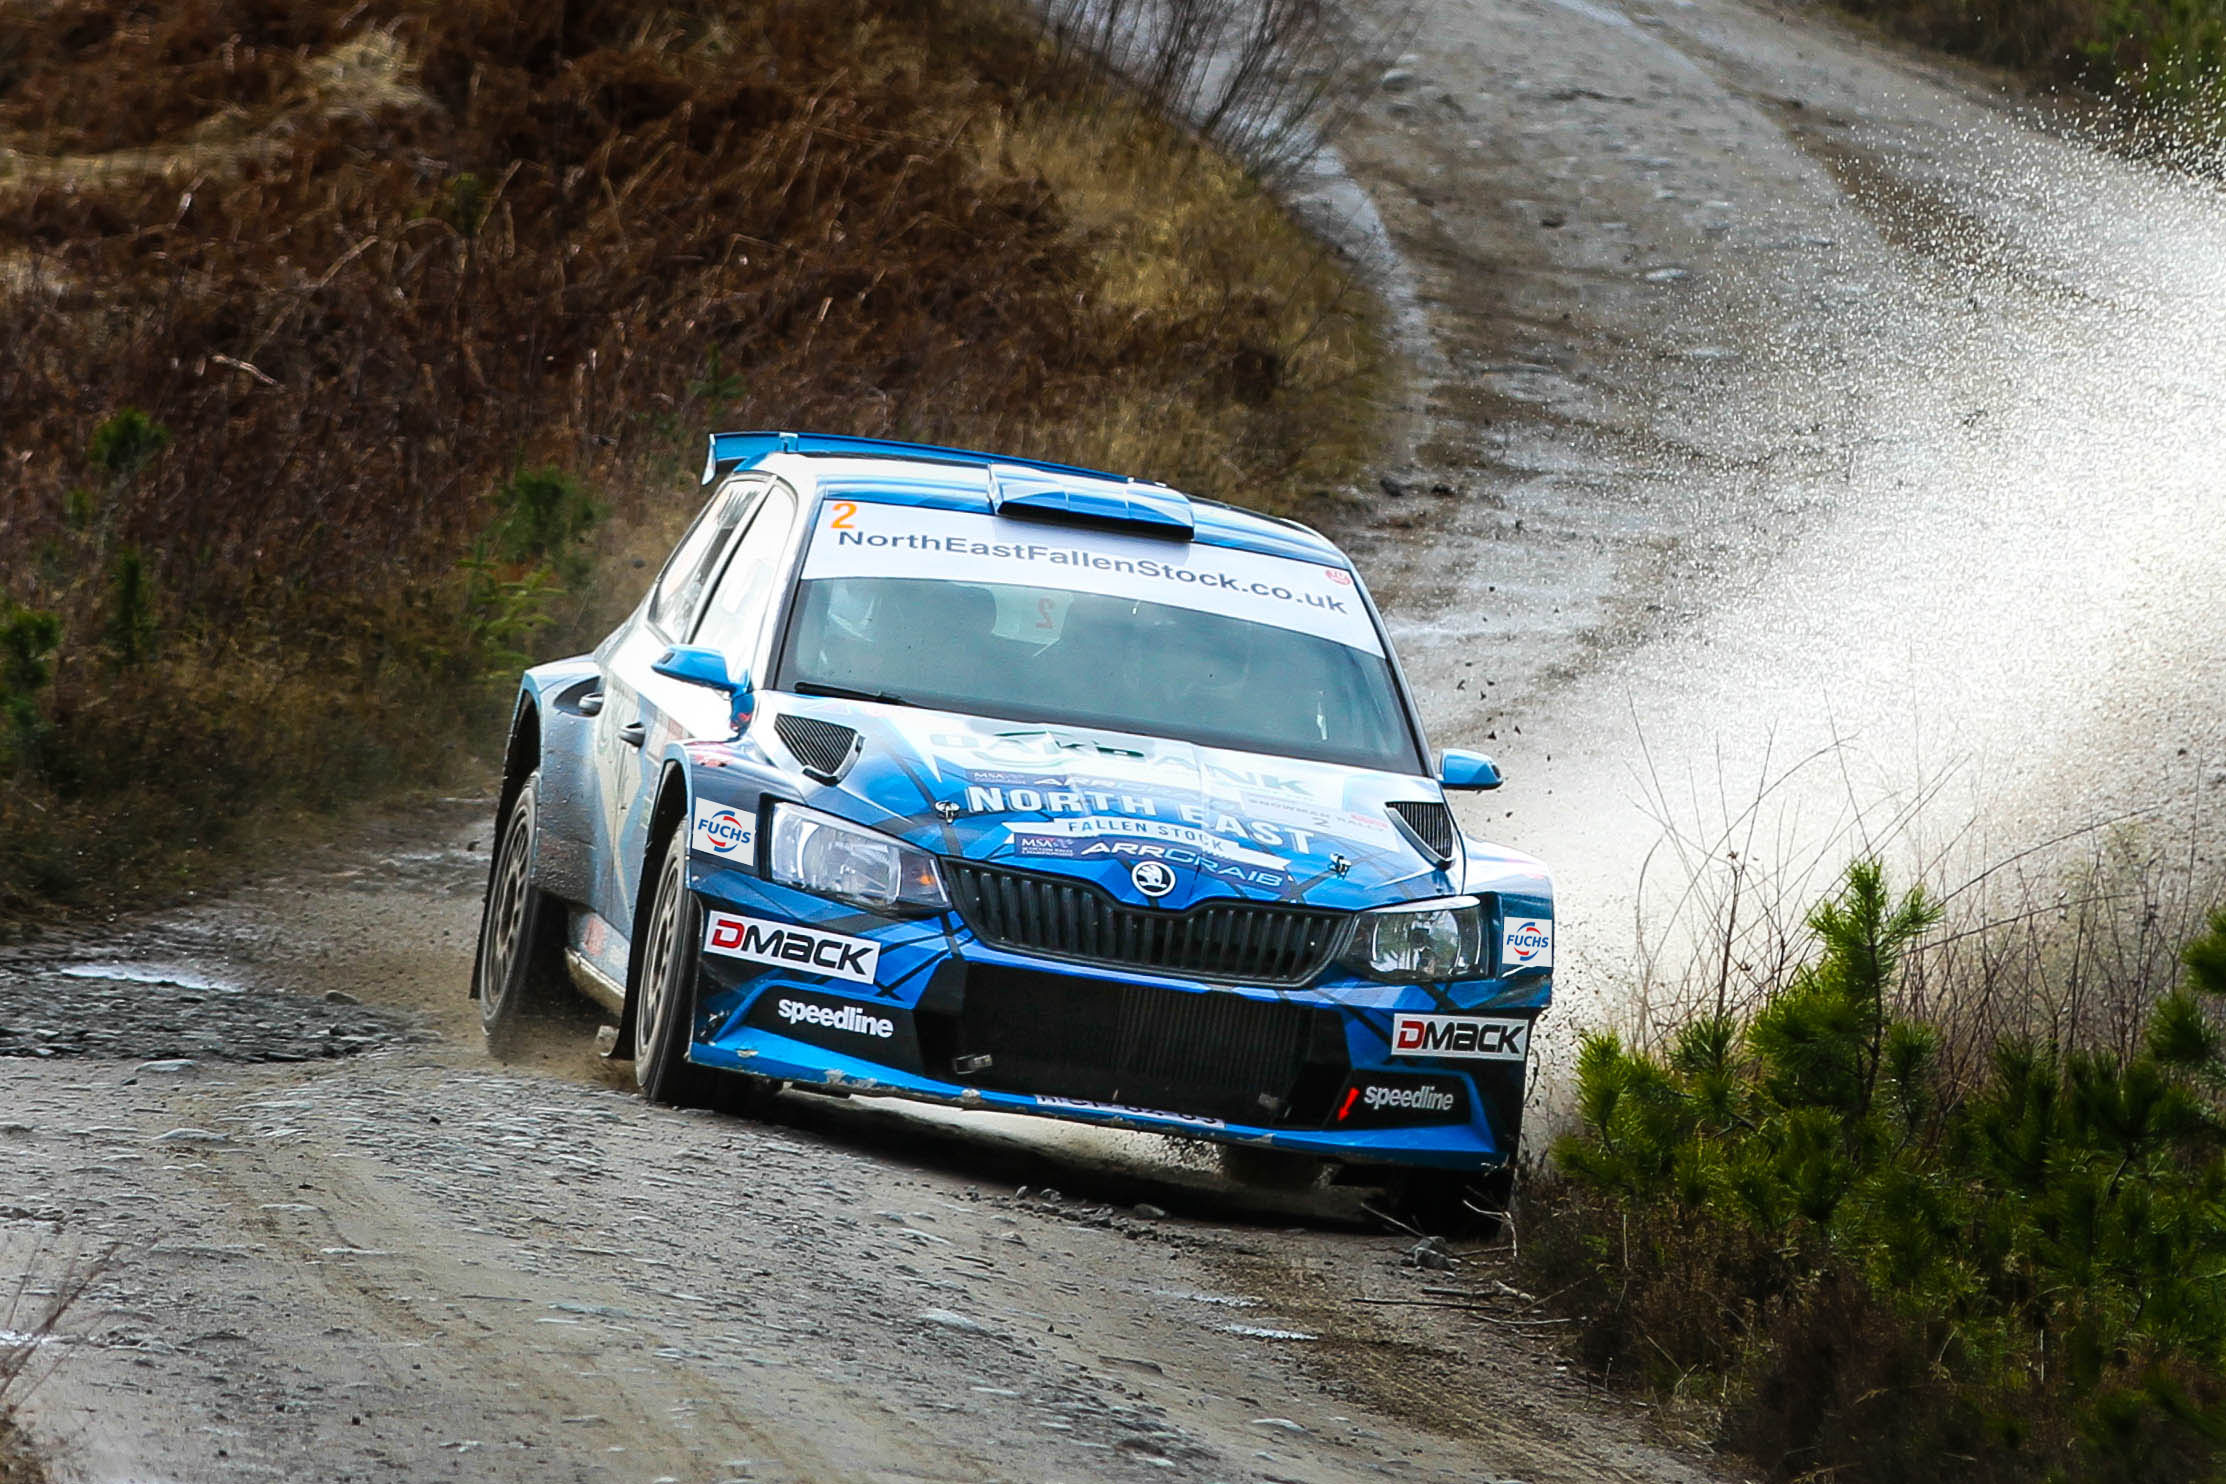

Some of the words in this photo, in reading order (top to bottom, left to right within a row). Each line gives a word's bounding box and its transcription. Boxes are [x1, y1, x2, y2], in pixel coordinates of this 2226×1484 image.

[831, 502, 857, 529] 2
[838, 530, 1348, 615] NorthEastFallenStock.co.uk
[698, 818, 751, 845] FUCHS
[967, 786, 1158, 816] NORTH
[1180, 803, 1315, 855] EAST
[1021, 837, 1054, 849] MSA
[1068, 819, 1148, 833] FALLEN
[1157, 825, 1224, 851] STOCK
[1506, 934, 1549, 949] FUCHS
[777, 998, 895, 1039] speedline
[1363, 1084, 1455, 1112] speedline
